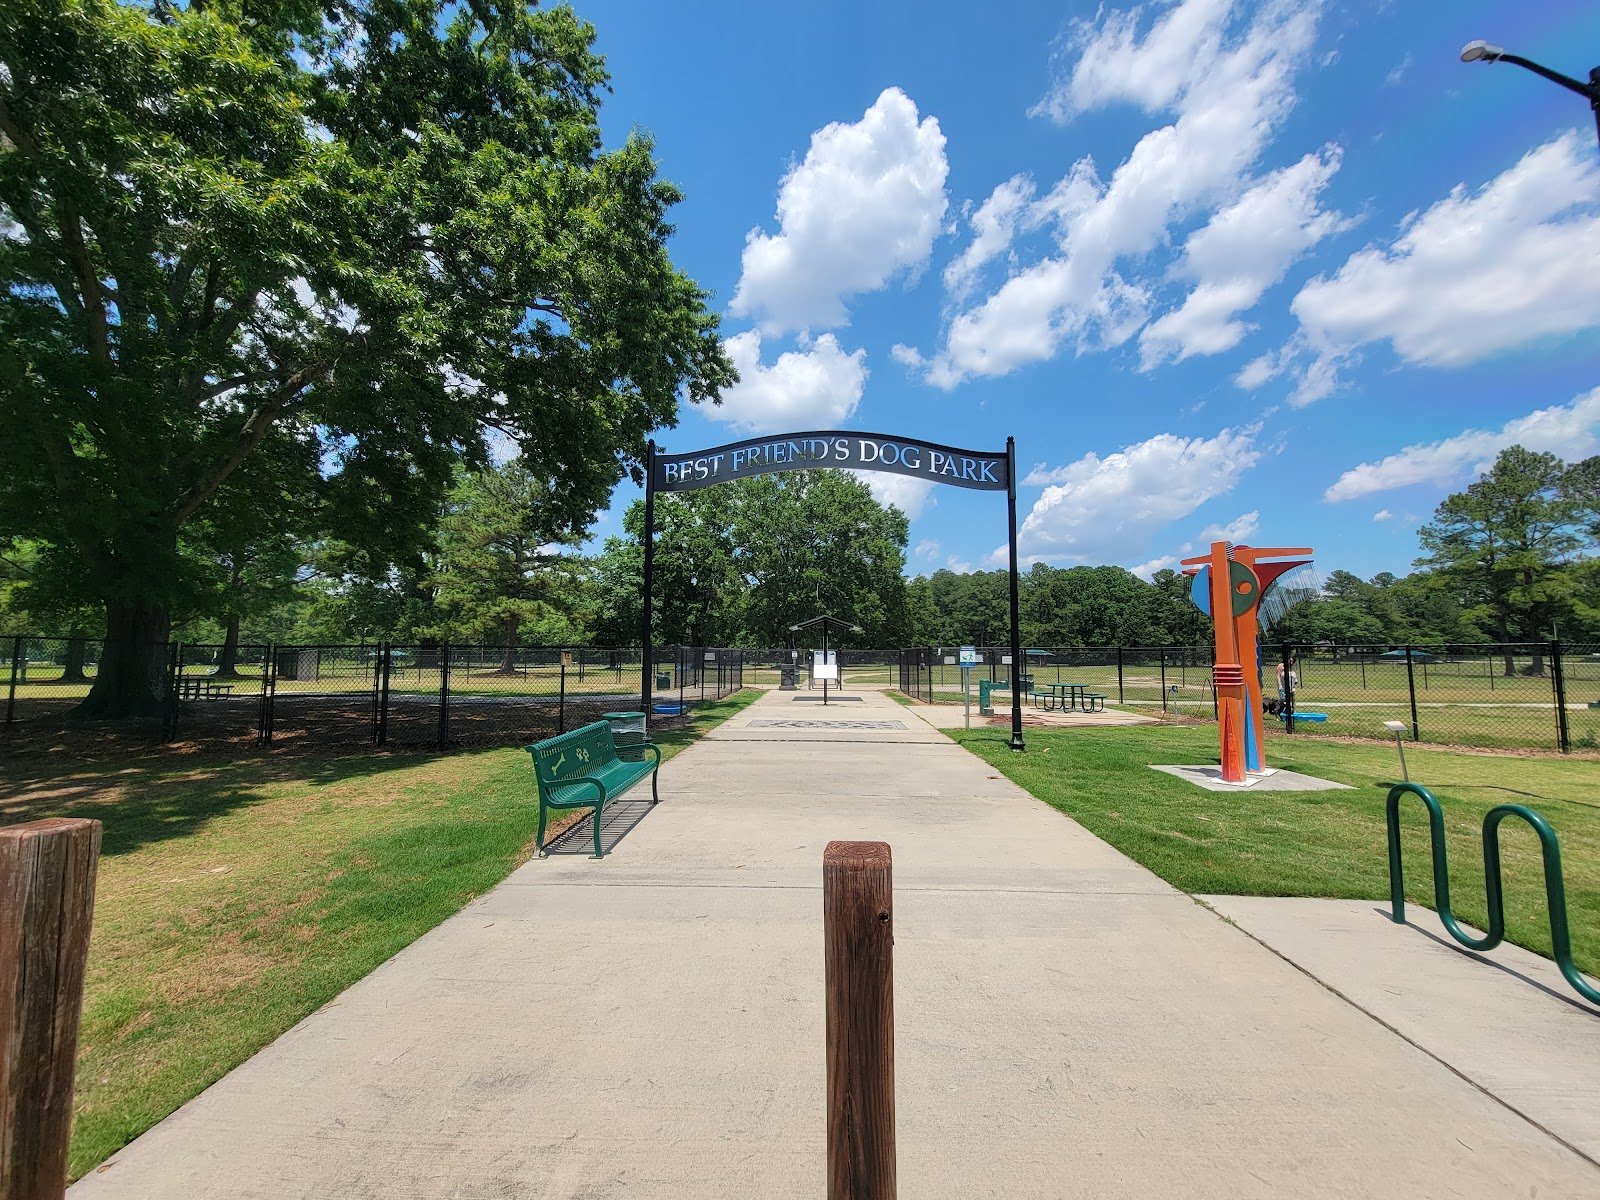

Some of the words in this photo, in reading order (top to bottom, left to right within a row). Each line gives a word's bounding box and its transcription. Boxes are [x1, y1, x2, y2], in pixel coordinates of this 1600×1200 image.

[663, 454, 724, 484] BEST
[731, 437, 850, 472] FRIEND'S
[858, 440, 921, 469] DOG
[928, 450, 999, 483] PARK
